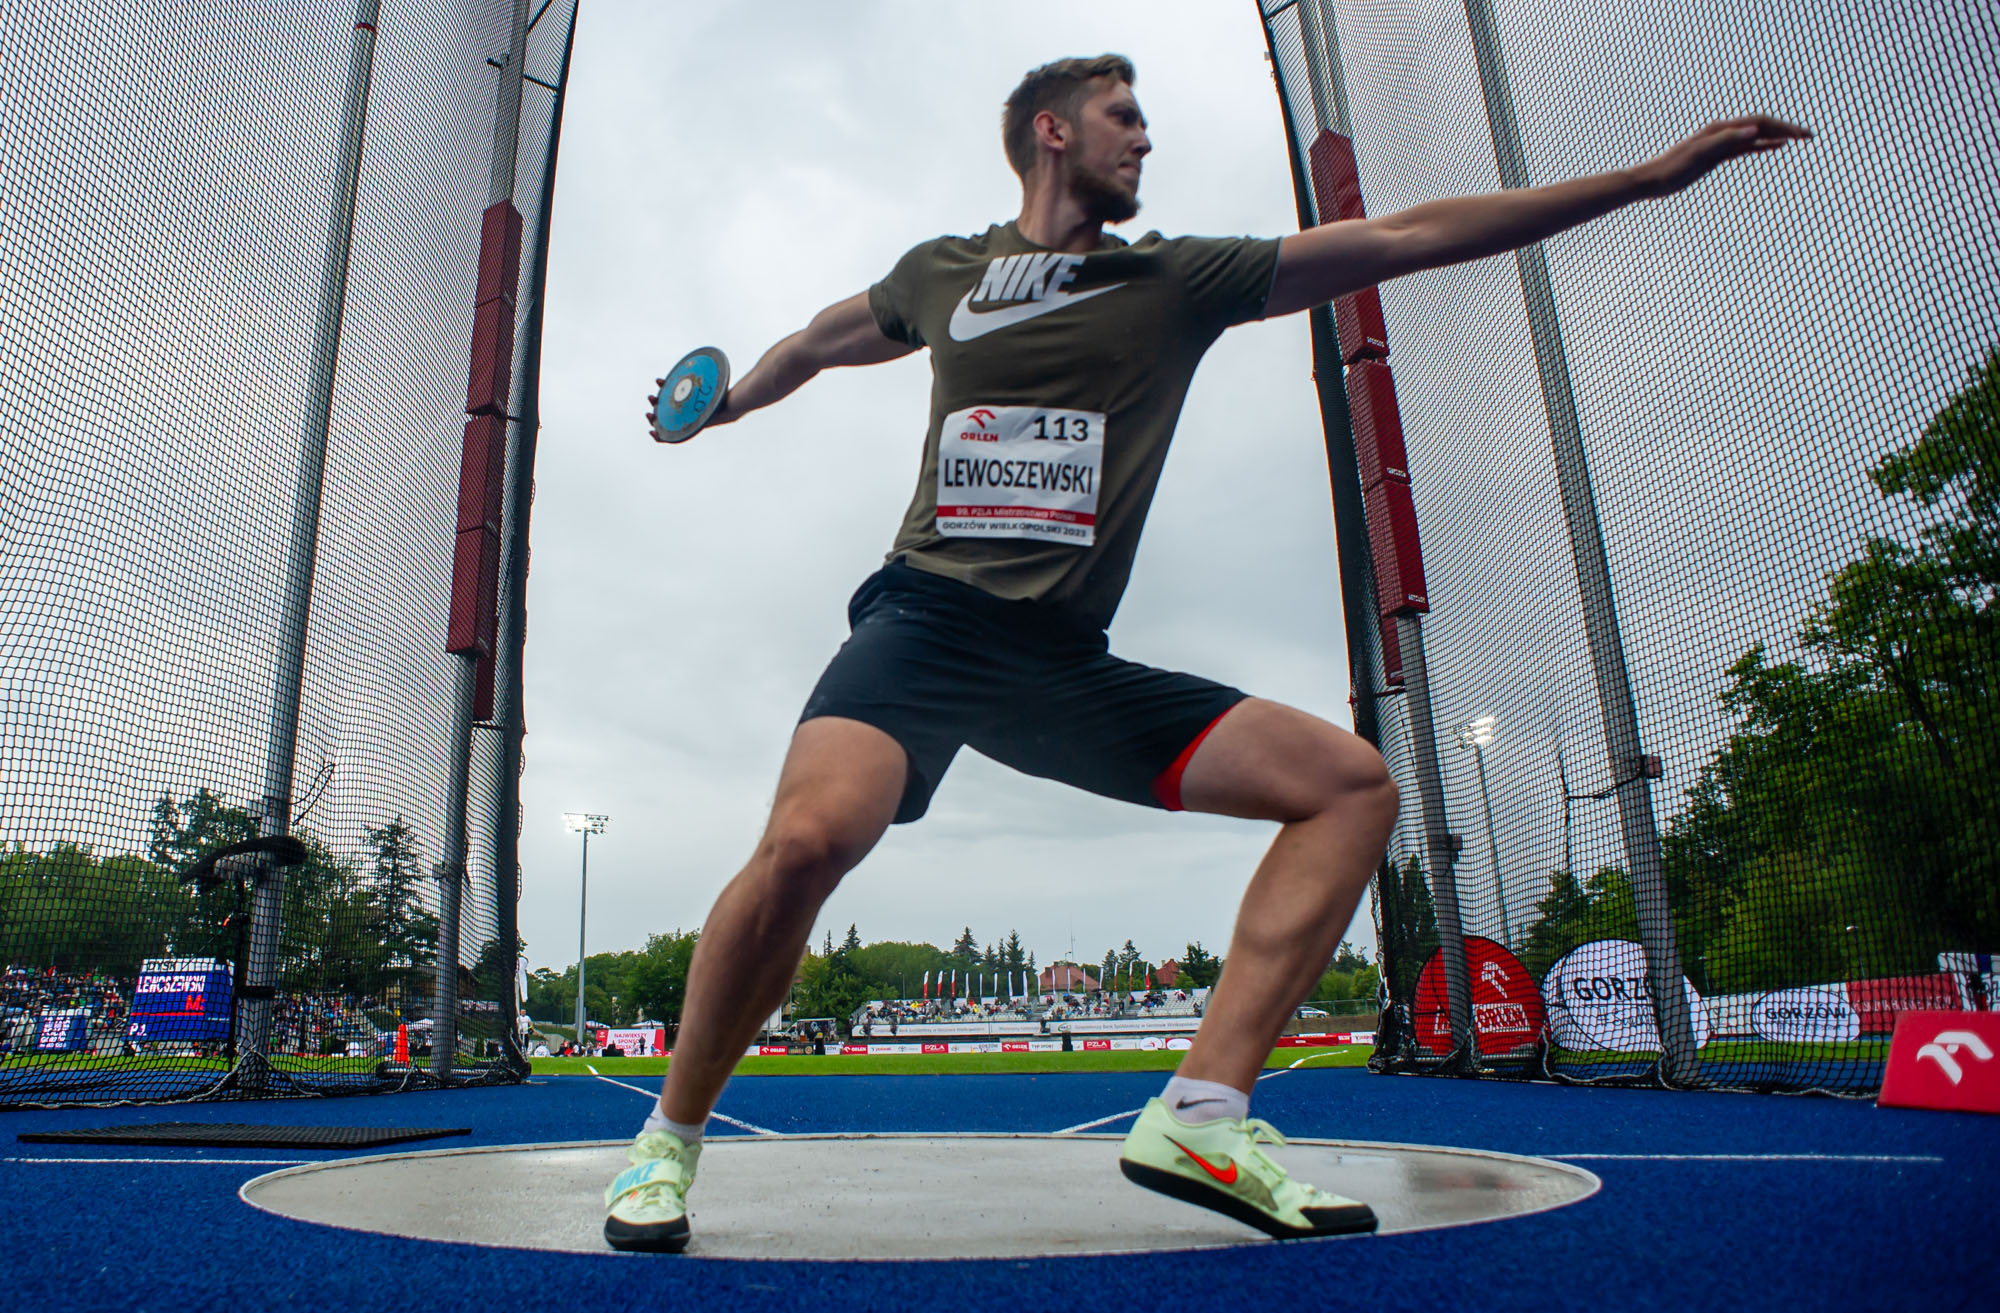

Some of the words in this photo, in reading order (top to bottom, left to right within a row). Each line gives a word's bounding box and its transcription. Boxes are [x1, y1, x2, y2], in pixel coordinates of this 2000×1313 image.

[972, 252, 1087, 302] NIKE
[960, 432, 999, 443] ORLEN
[1033, 414, 1089, 442] 113
[944, 458, 1094, 494] LEWOSZEWSKI
[971, 507, 993, 516] PZLA
[994, 508, 1049, 518] Mistrzostwa
[1050, 510, 1077, 521] Polski
[942, 520, 987, 530] GORZÓW
[989, 522, 1062, 534] WIELKOPOLSKI
[1063, 527, 1087, 537] 2023
[1573, 976, 1653, 1000] GORZ
[1767, 1003, 1846, 1019] GORZÓW
